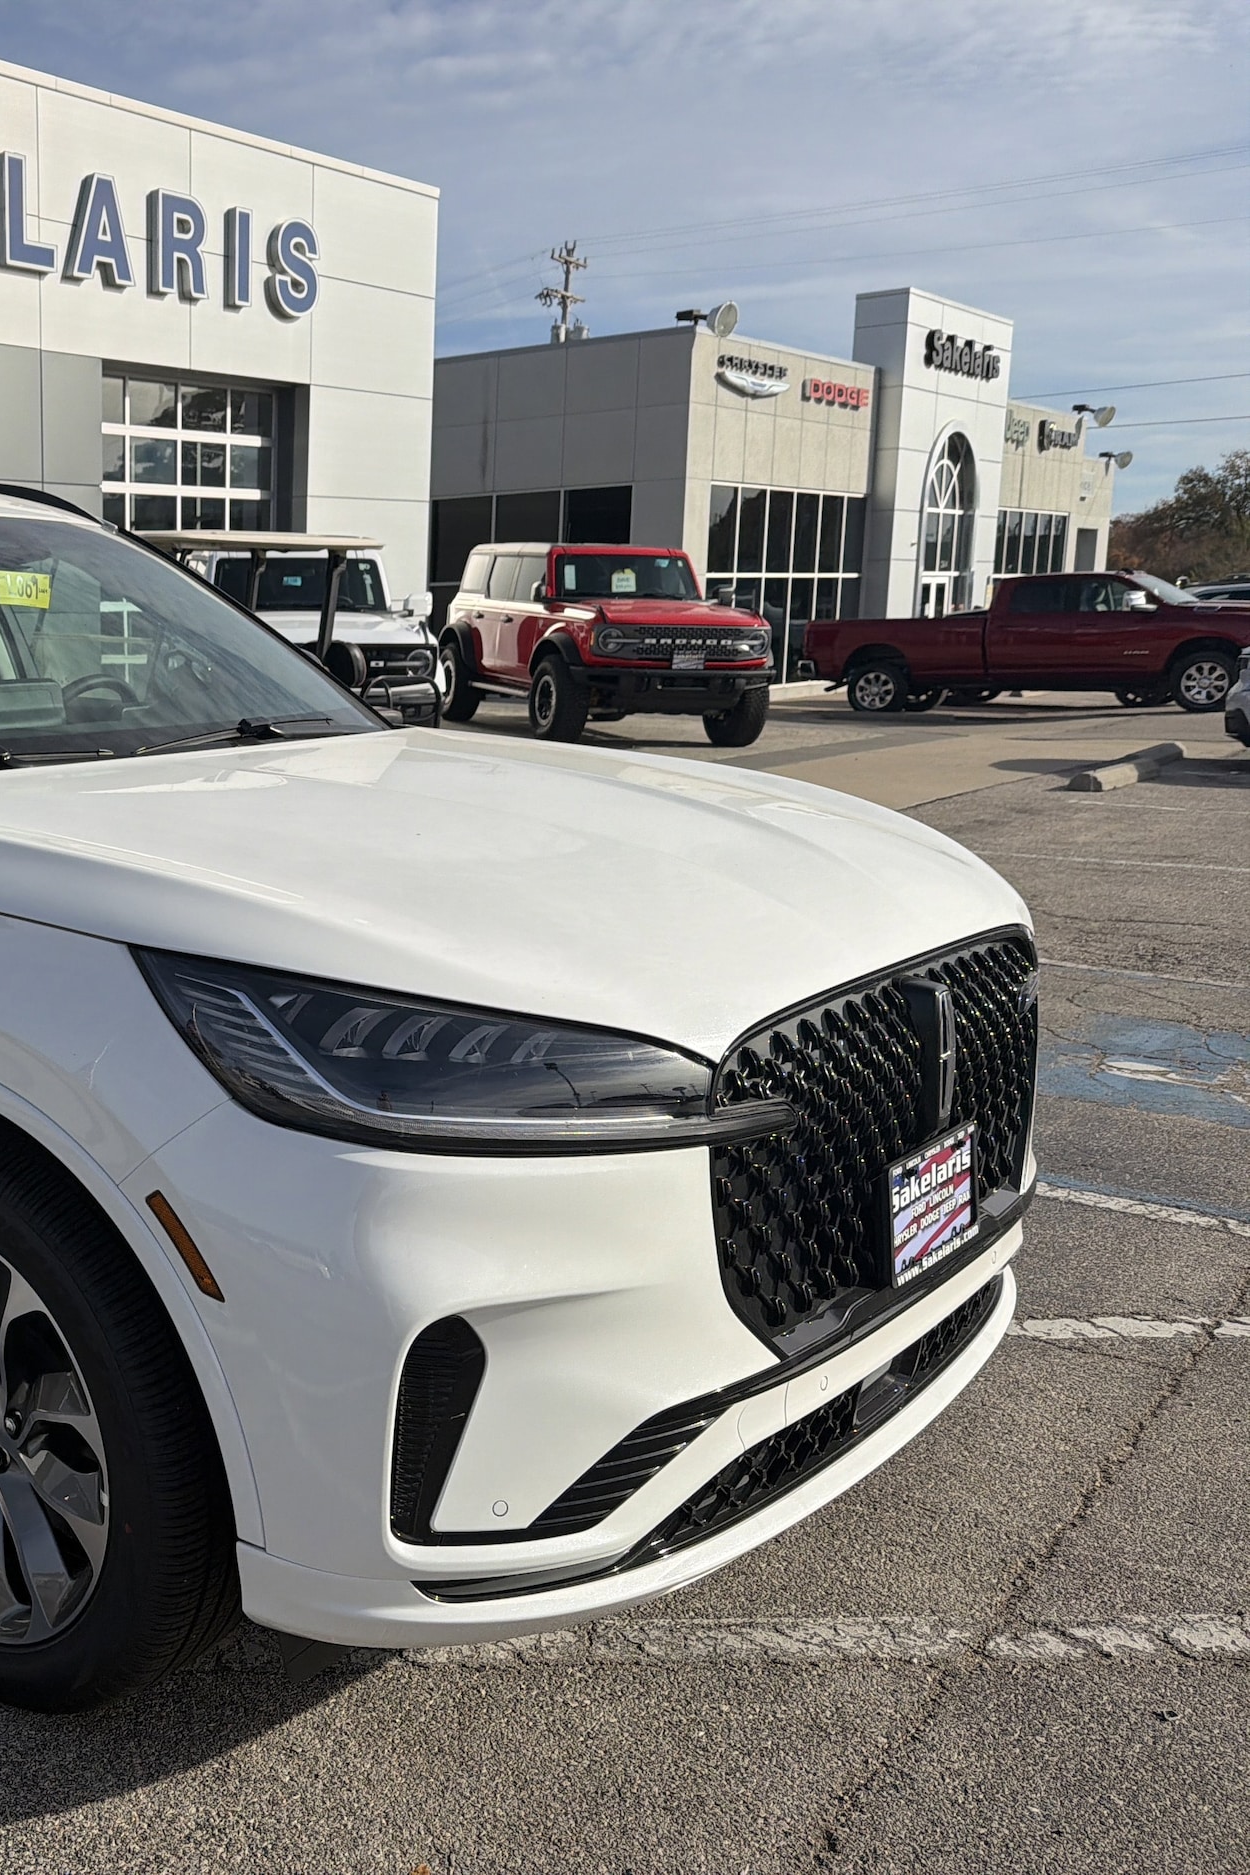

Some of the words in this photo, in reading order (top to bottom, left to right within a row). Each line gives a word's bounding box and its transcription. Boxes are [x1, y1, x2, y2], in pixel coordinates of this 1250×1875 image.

[926, 328, 1001, 380] Sakelaris
[807, 378, 869, 408] DODGE
[892, 1149, 971, 1213] Sakelaris
[911, 1201, 927, 1219] FORD
[929, 1184, 954, 1207] LINCOLN
[894, 1223, 918, 1248] HRYSLER
[920, 1208, 940, 1229] DODGE
[941, 1198, 957, 1215] JEEP
[896, 1225, 979, 1287] www.Sakelaris.com
